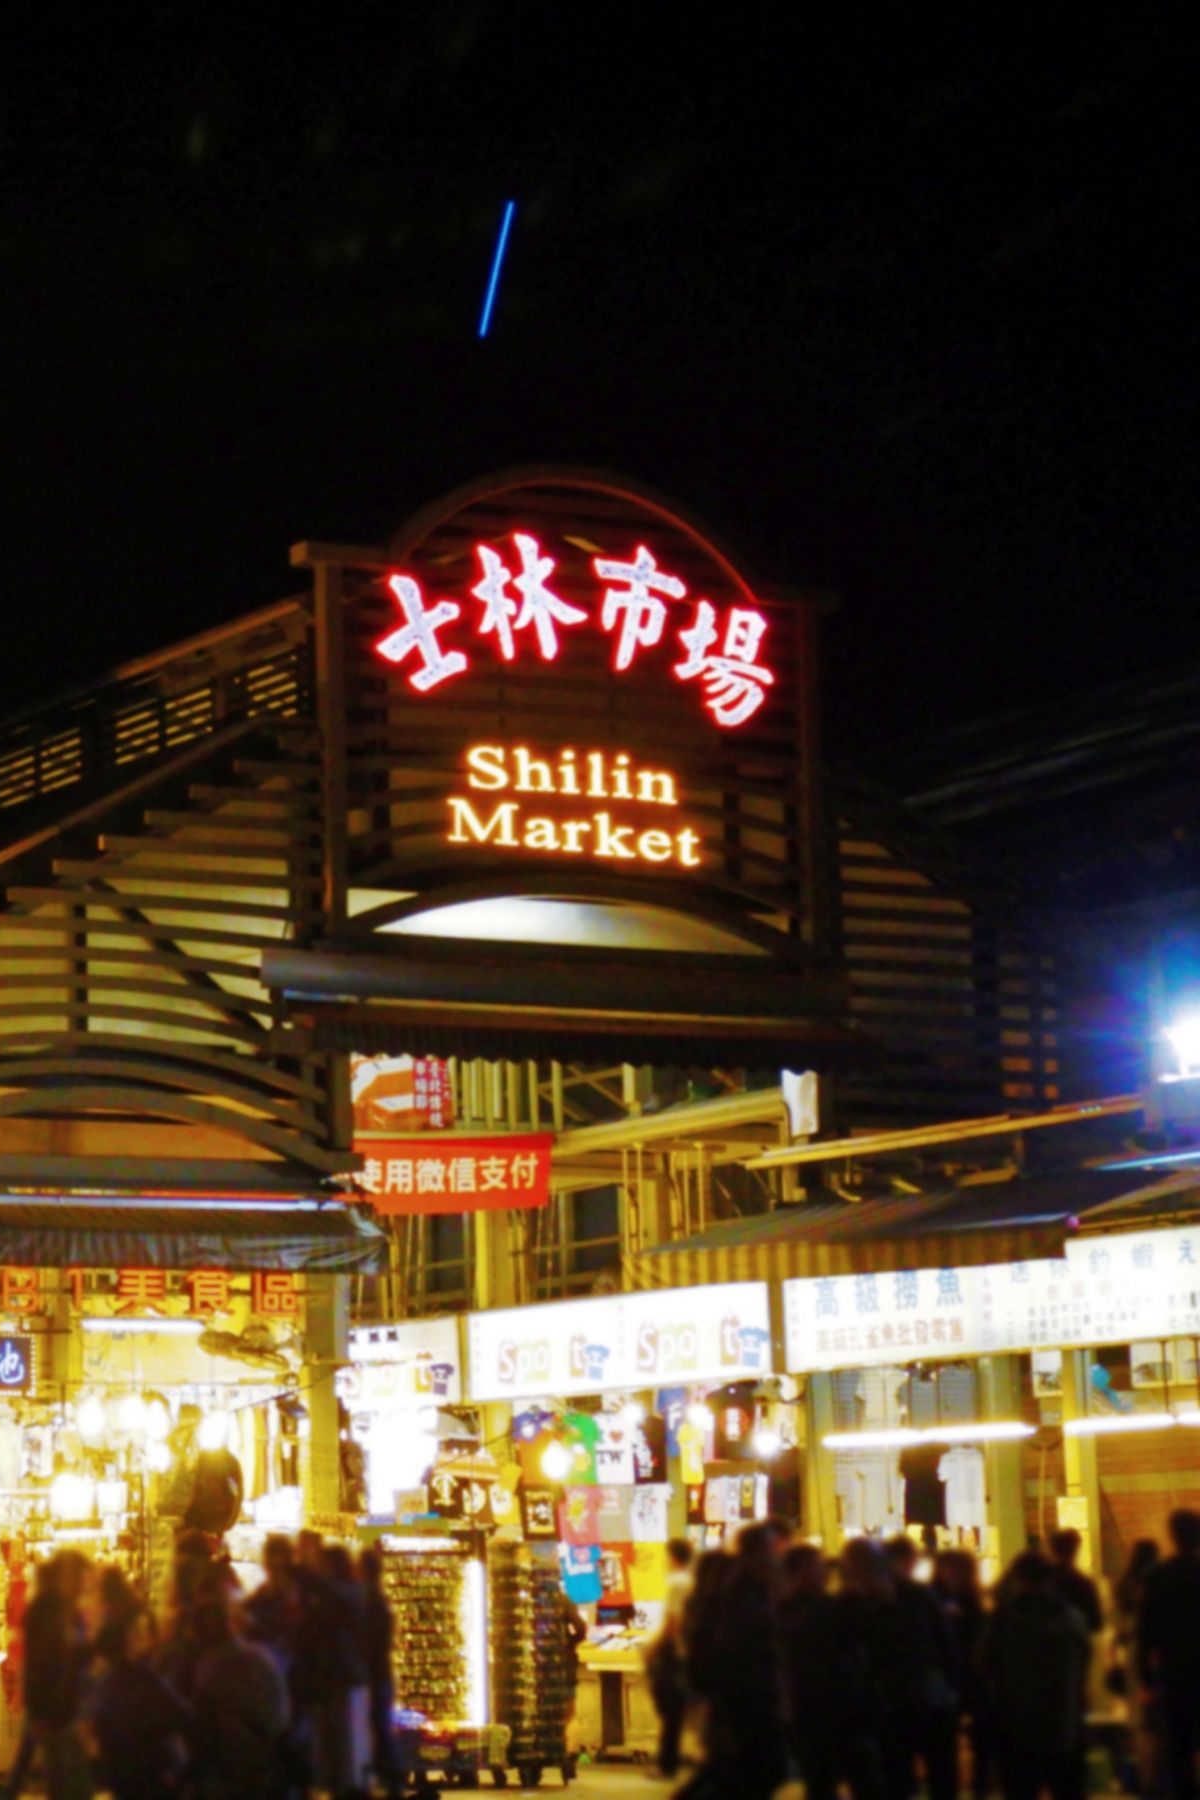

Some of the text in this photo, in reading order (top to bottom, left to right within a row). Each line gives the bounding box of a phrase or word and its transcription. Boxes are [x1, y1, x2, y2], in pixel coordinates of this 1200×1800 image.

[376, 533, 774, 726] 士林市場
[467, 745, 677, 804] Shilin
[447, 797, 701, 866] Market
